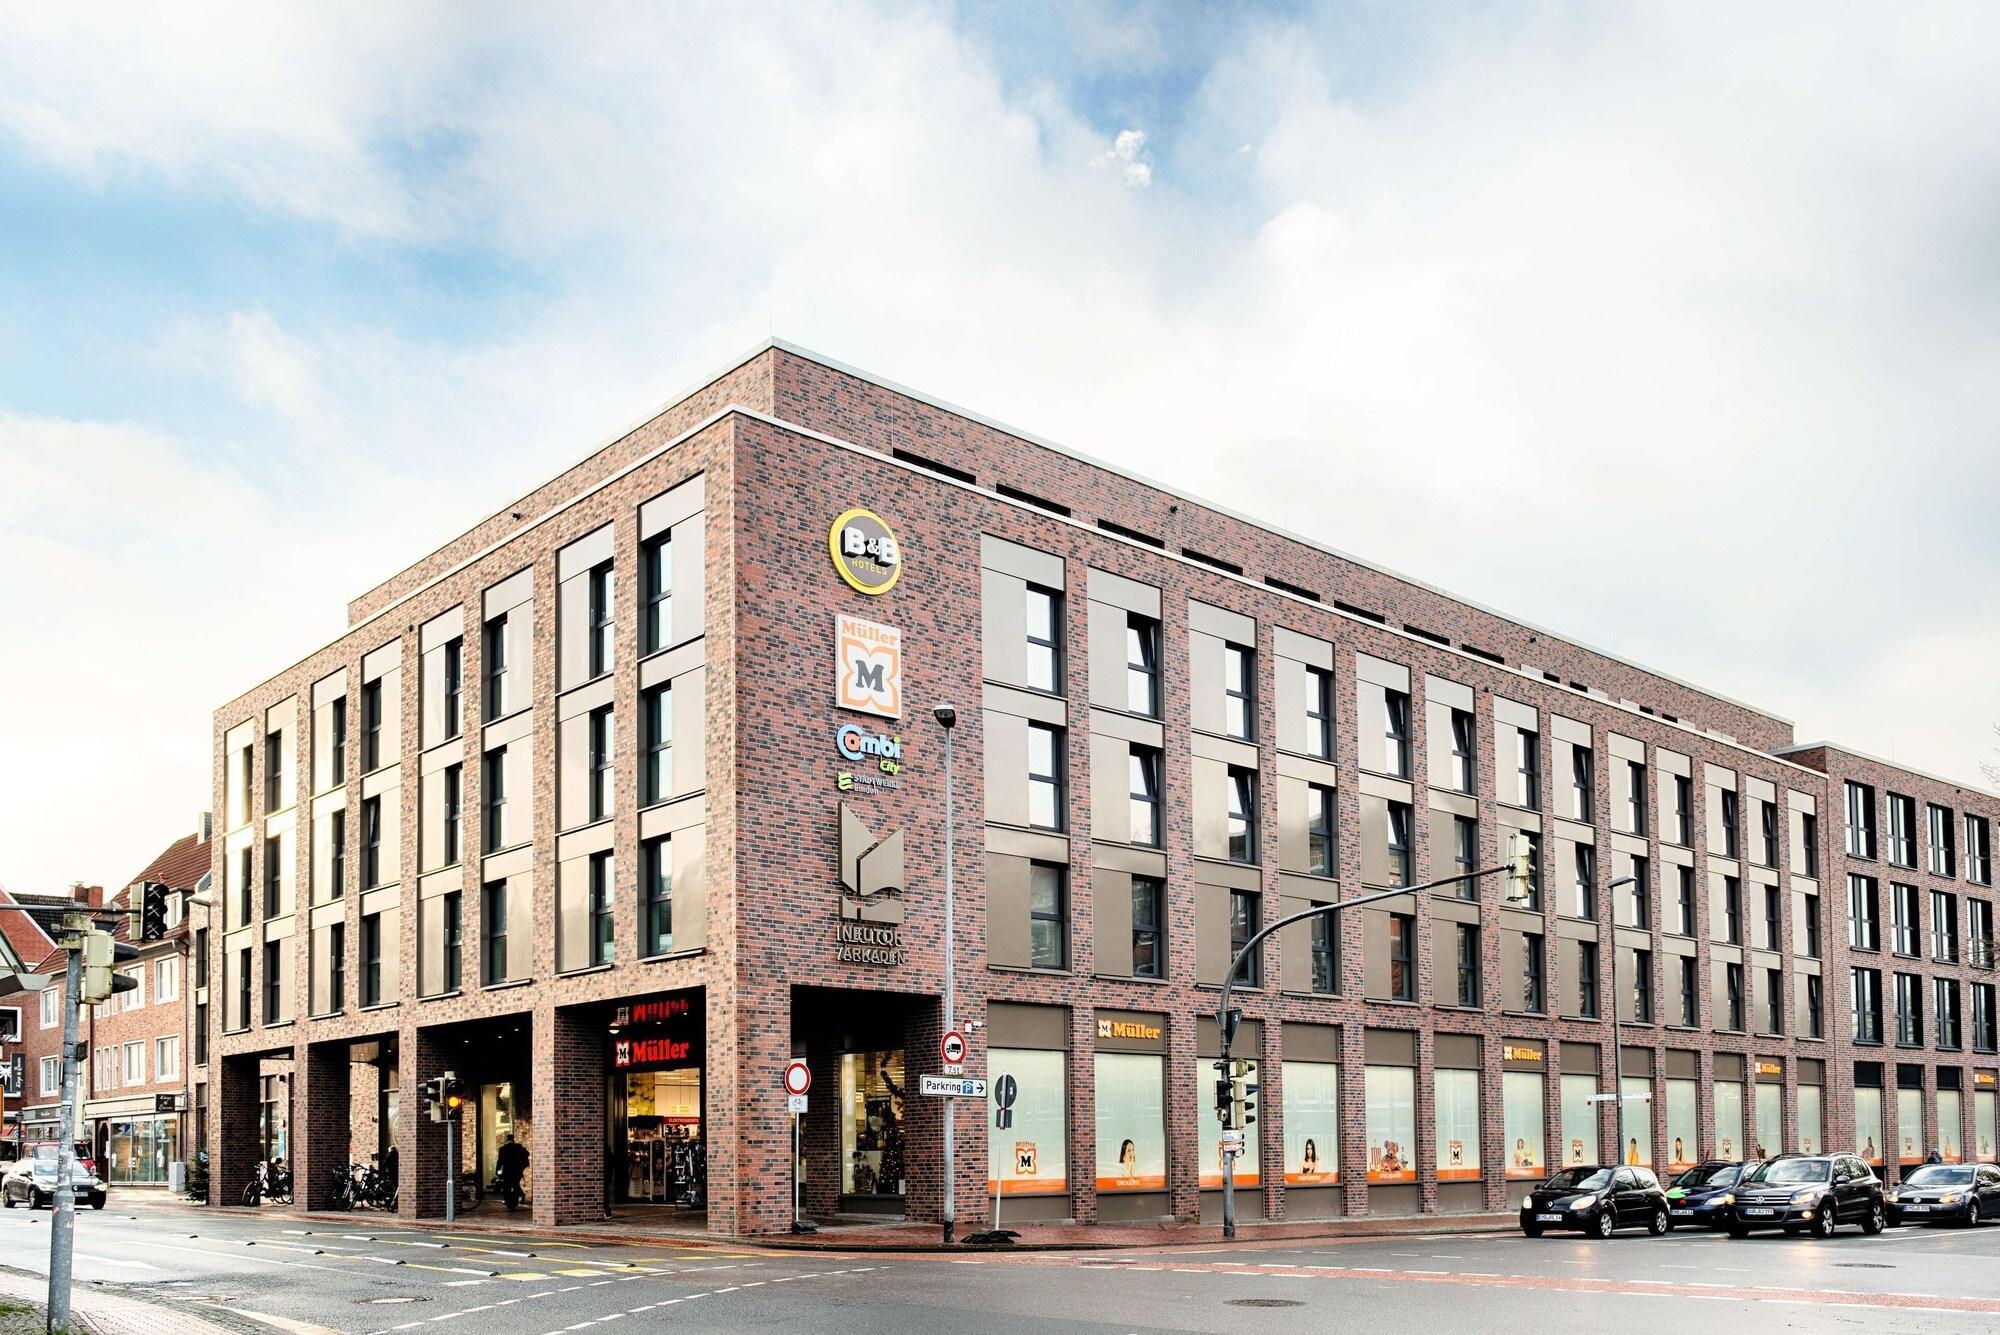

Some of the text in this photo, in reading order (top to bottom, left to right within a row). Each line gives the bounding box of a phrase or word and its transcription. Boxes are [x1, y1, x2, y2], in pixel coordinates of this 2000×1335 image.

[842, 527, 898, 566] B&B
[851, 558, 888, 576] HOTELS
[842, 619, 897, 646] Müller
[855, 659, 885, 693] M
[837, 724, 901, 761] Combi
[1113, 1022, 1160, 1039] Müller
[632, 1039, 689, 1063] Müller
[1513, 1047, 1542, 1061] Müller
[926, 1080, 961, 1094] Parkring
[1020, 1155, 1032, 1168] M
